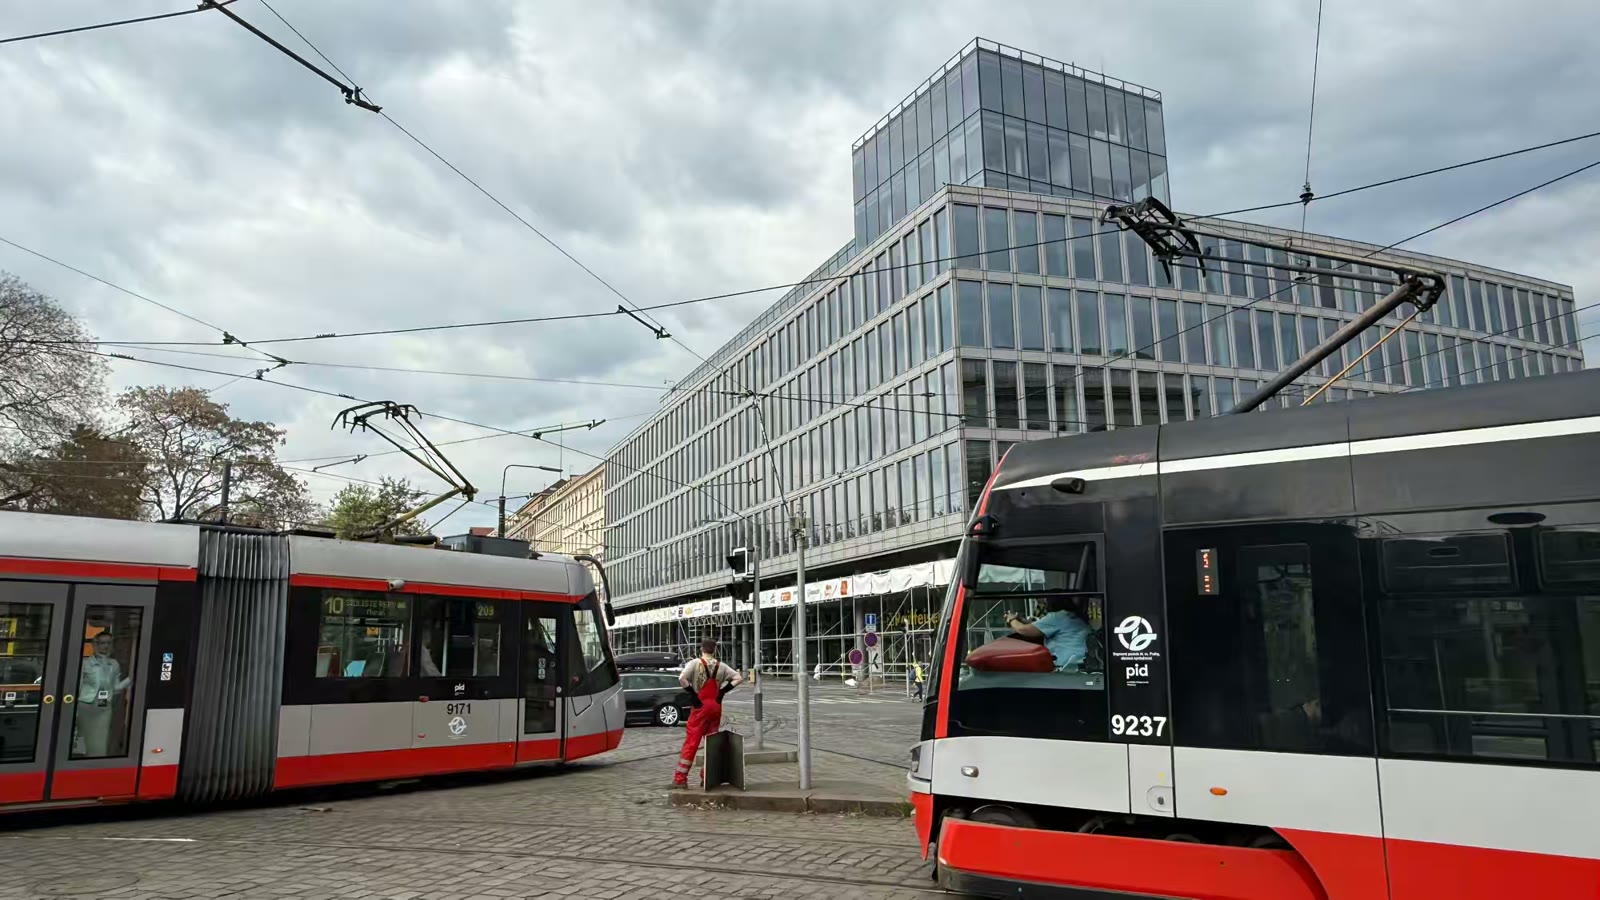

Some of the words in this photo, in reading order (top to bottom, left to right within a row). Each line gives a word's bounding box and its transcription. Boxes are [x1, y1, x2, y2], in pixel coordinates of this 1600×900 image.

[325, 596, 344, 614] 10
[1126, 663, 1149, 680] pid
[454, 683, 465, 692] pid
[446, 702, 471, 715] 9171
[1111, 714, 1167, 737] 9237
